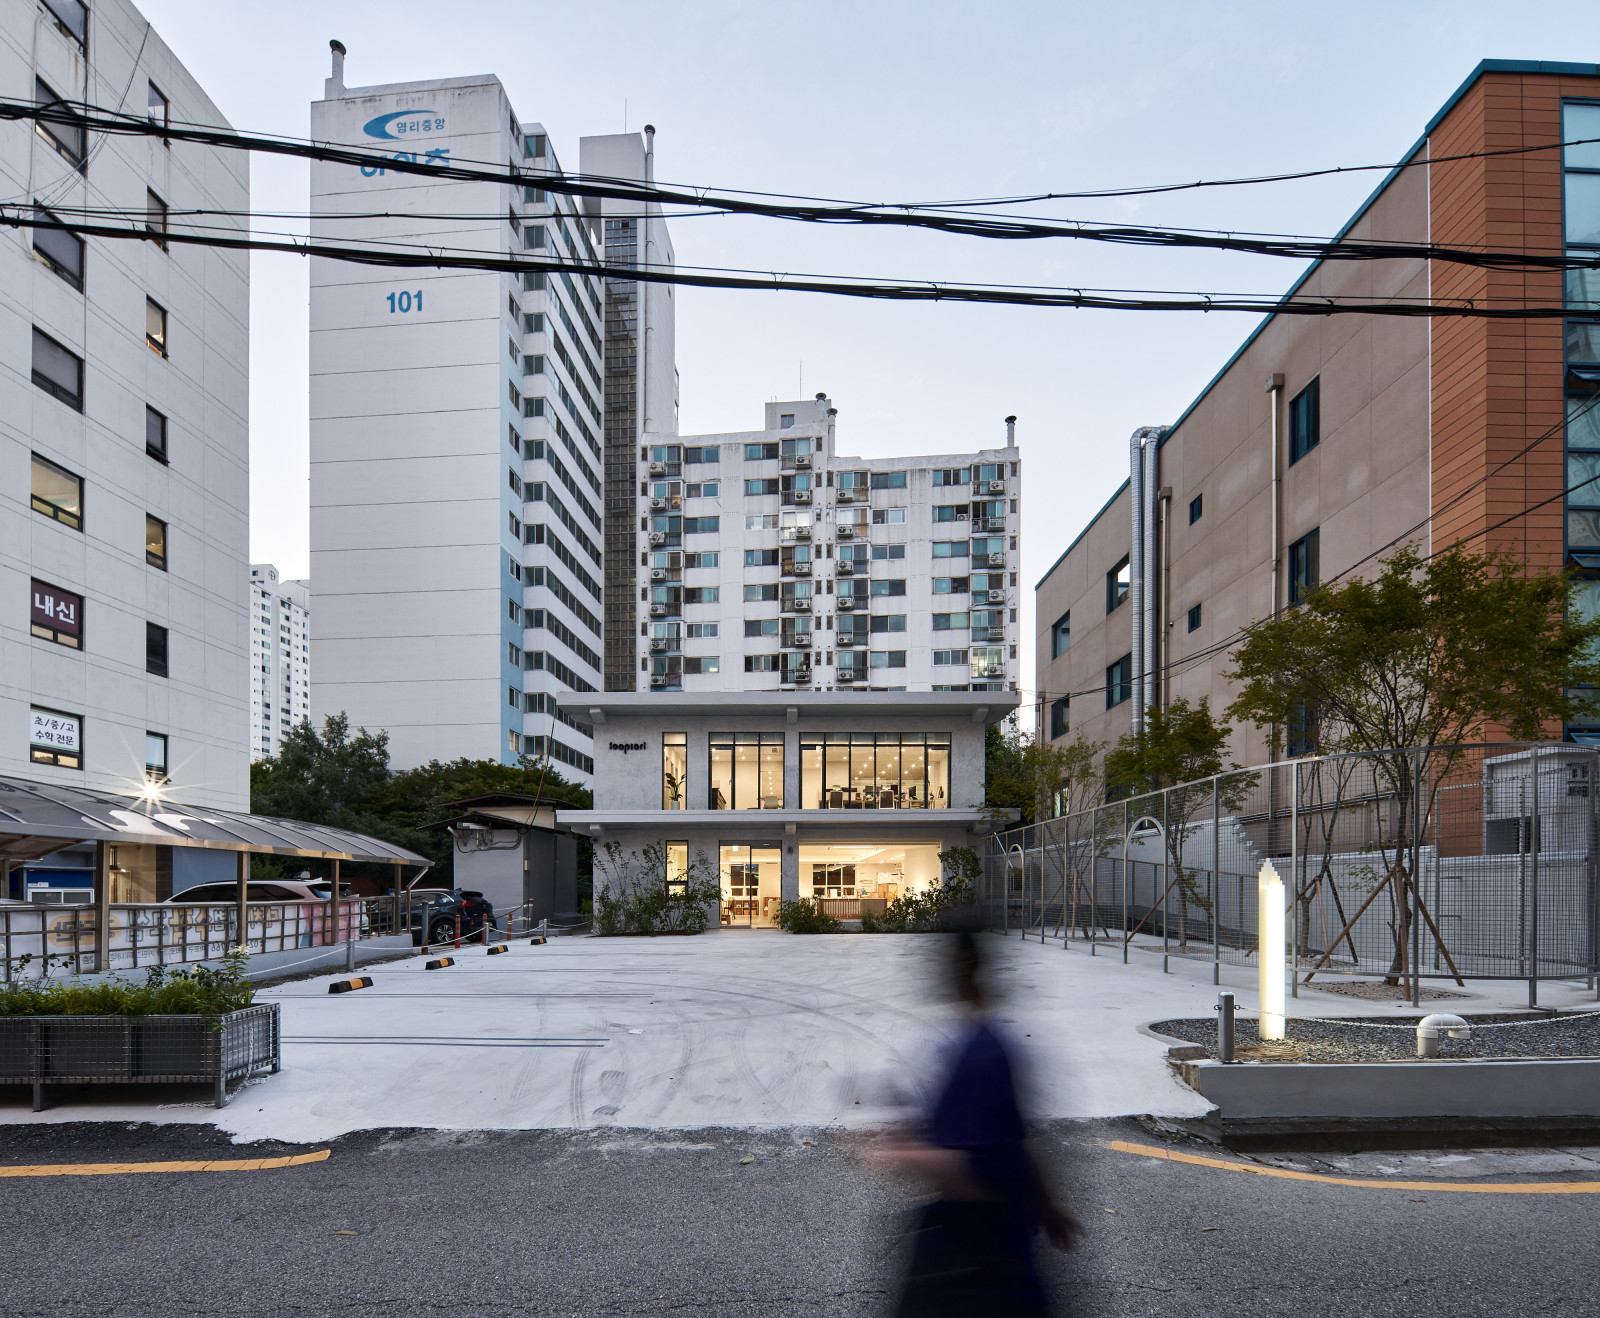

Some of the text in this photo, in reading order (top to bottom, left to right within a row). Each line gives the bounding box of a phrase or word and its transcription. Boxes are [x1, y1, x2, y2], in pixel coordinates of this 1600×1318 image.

[396, 118, 446, 134] 염리중앙
[386, 289, 423, 314] 101
[34, 592, 75, 625] 내신
[34, 716, 75, 733] 초/중/고
[35, 730, 74, 746] 수학 전문
